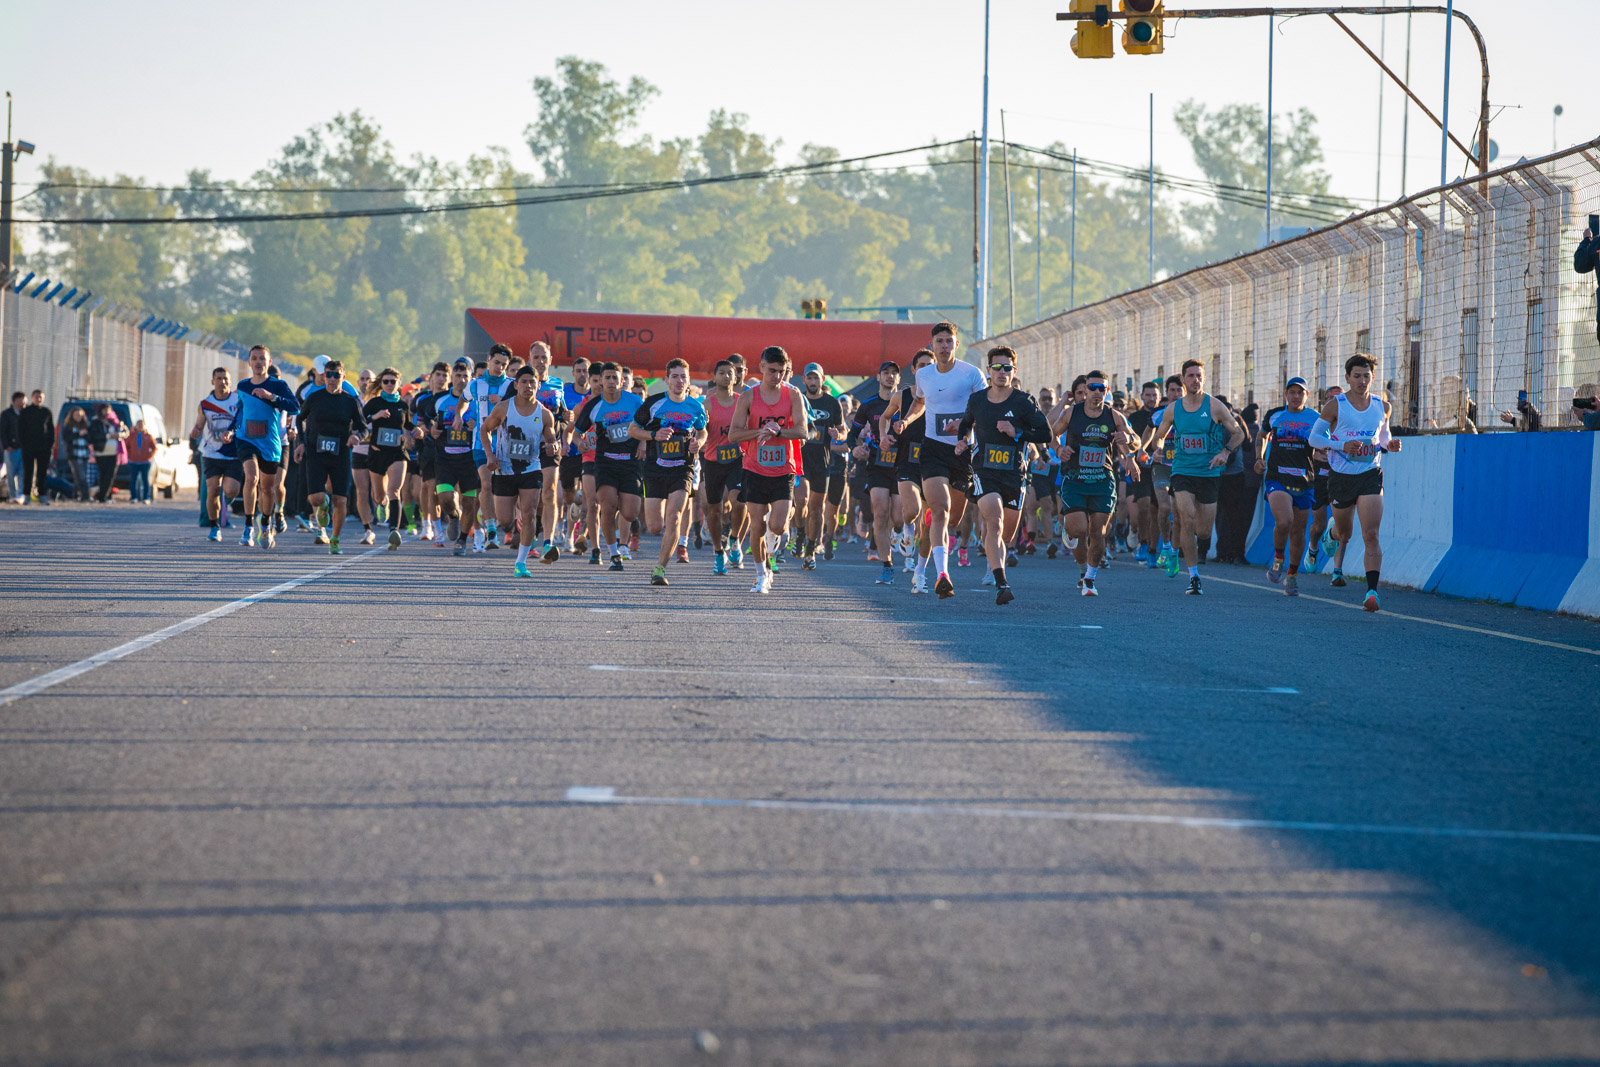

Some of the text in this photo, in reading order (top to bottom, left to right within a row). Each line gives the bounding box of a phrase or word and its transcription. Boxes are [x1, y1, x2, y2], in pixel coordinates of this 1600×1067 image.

[384, 432, 394, 442] 21
[450, 430, 467, 440] 756
[611, 426, 628, 439] 105
[321, 440, 336, 452] 167
[511, 443, 530, 455] 174
[661, 441, 680, 454] 707
[1184, 438, 1203, 449] 344
[720, 448, 737, 461] 712
[762, 450, 781, 462] 313
[880, 450, 897, 464] 782
[988, 449, 1009, 464] 706
[1084, 451, 1101, 463] 317
